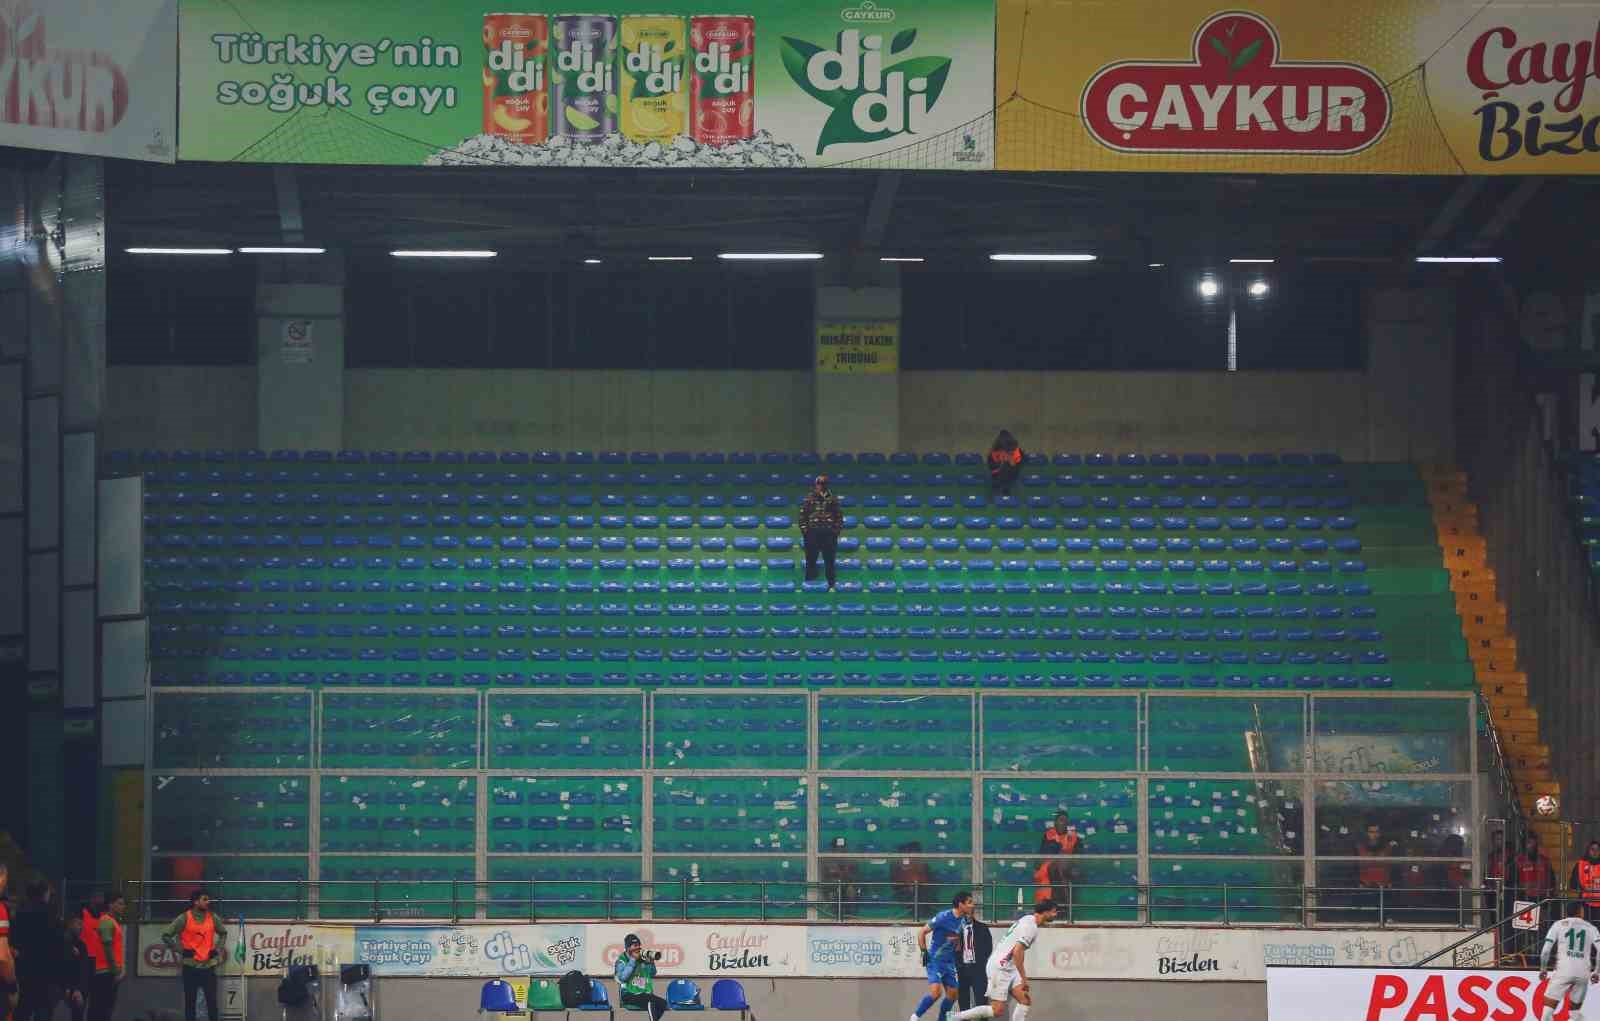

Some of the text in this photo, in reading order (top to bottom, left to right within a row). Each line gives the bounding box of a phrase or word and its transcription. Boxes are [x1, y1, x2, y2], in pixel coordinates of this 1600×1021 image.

[216, 75, 457, 114] soğuk çayı
[1106, 83, 1366, 140] ÇAYKUR
[1564, 927, 1586, 952] 11
[708, 949, 769, 971] Bizden
[1157, 953, 1218, 974] Bizden
[228, 991, 237, 1005] 7
